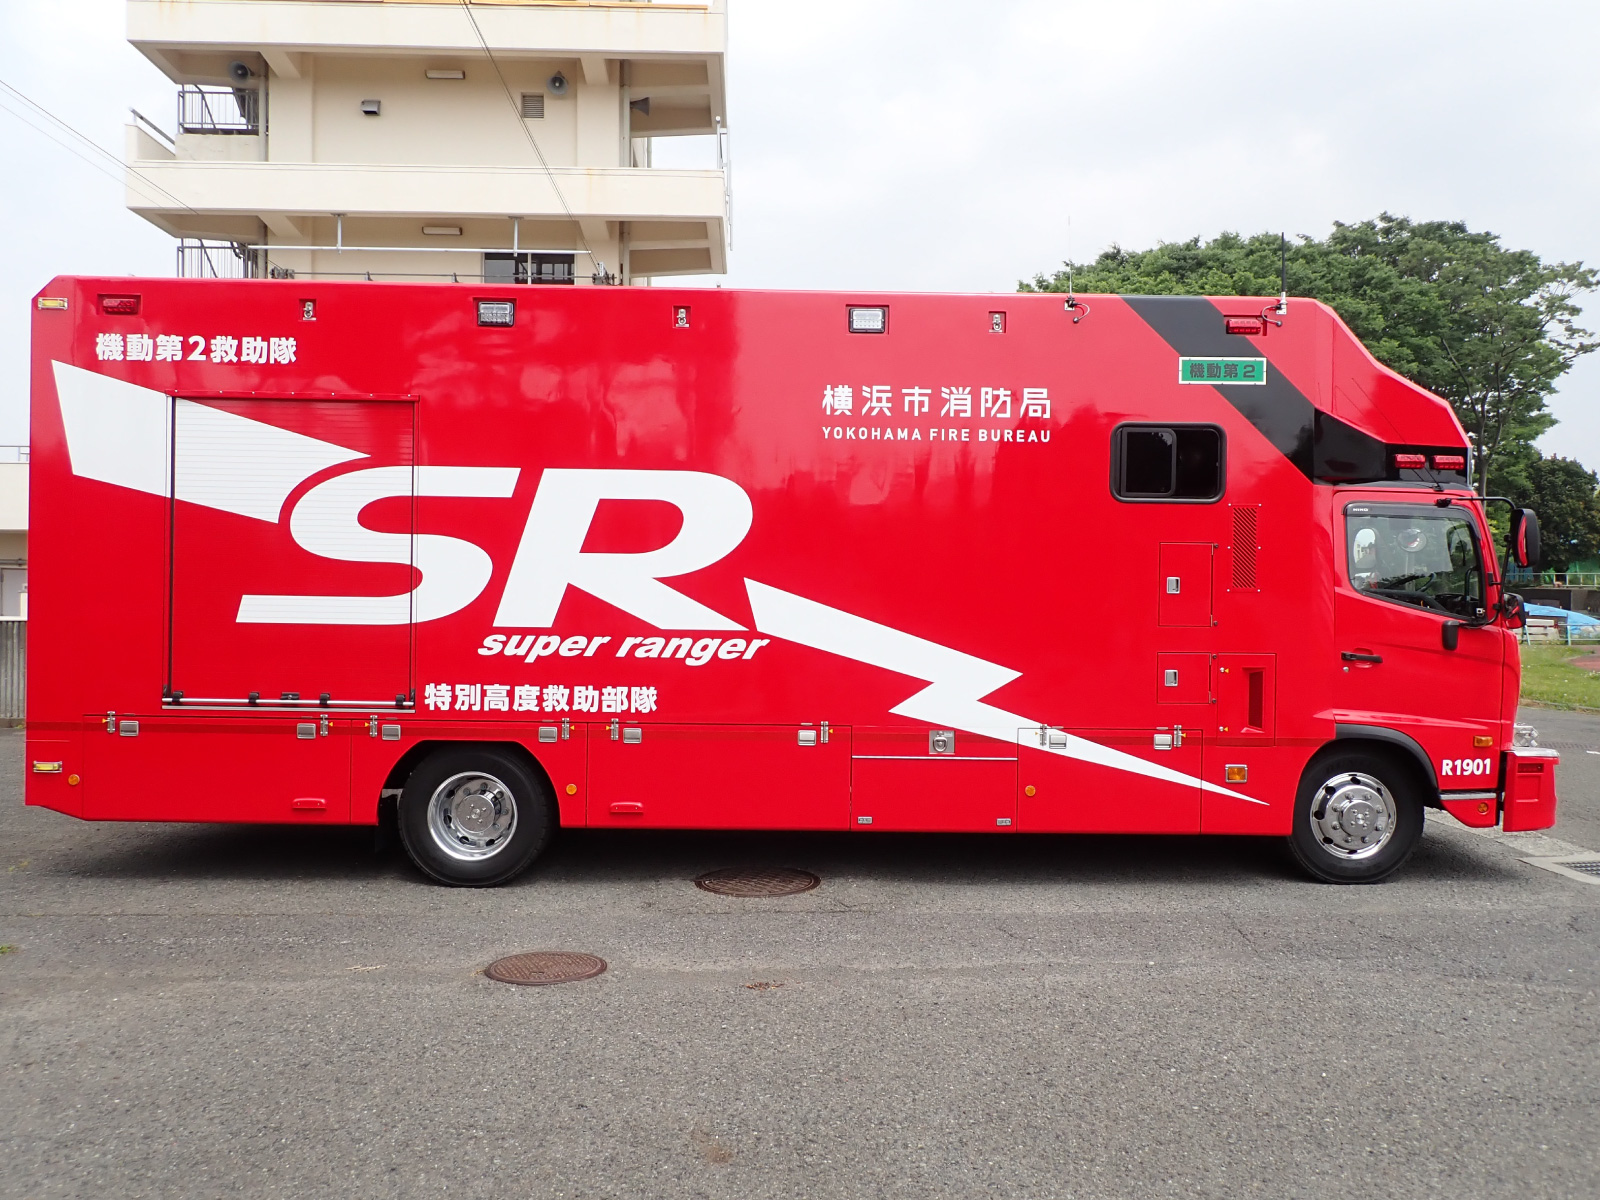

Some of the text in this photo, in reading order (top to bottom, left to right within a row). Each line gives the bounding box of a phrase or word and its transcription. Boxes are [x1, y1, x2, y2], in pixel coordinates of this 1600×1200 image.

[95, 332, 297, 365] 機動第2救助隊
[1189, 362, 1256, 379] 機動第2
[822, 384, 1052, 420] 横浜市消防局
[822, 426, 1051, 443] YOKOHAMA FIRE BUREAU
[235, 465, 754, 631] SR
[477, 633, 771, 667] super ranger
[424, 683, 658, 713] 特別高度救助部隊
[1441, 758, 1491, 776] R1901
